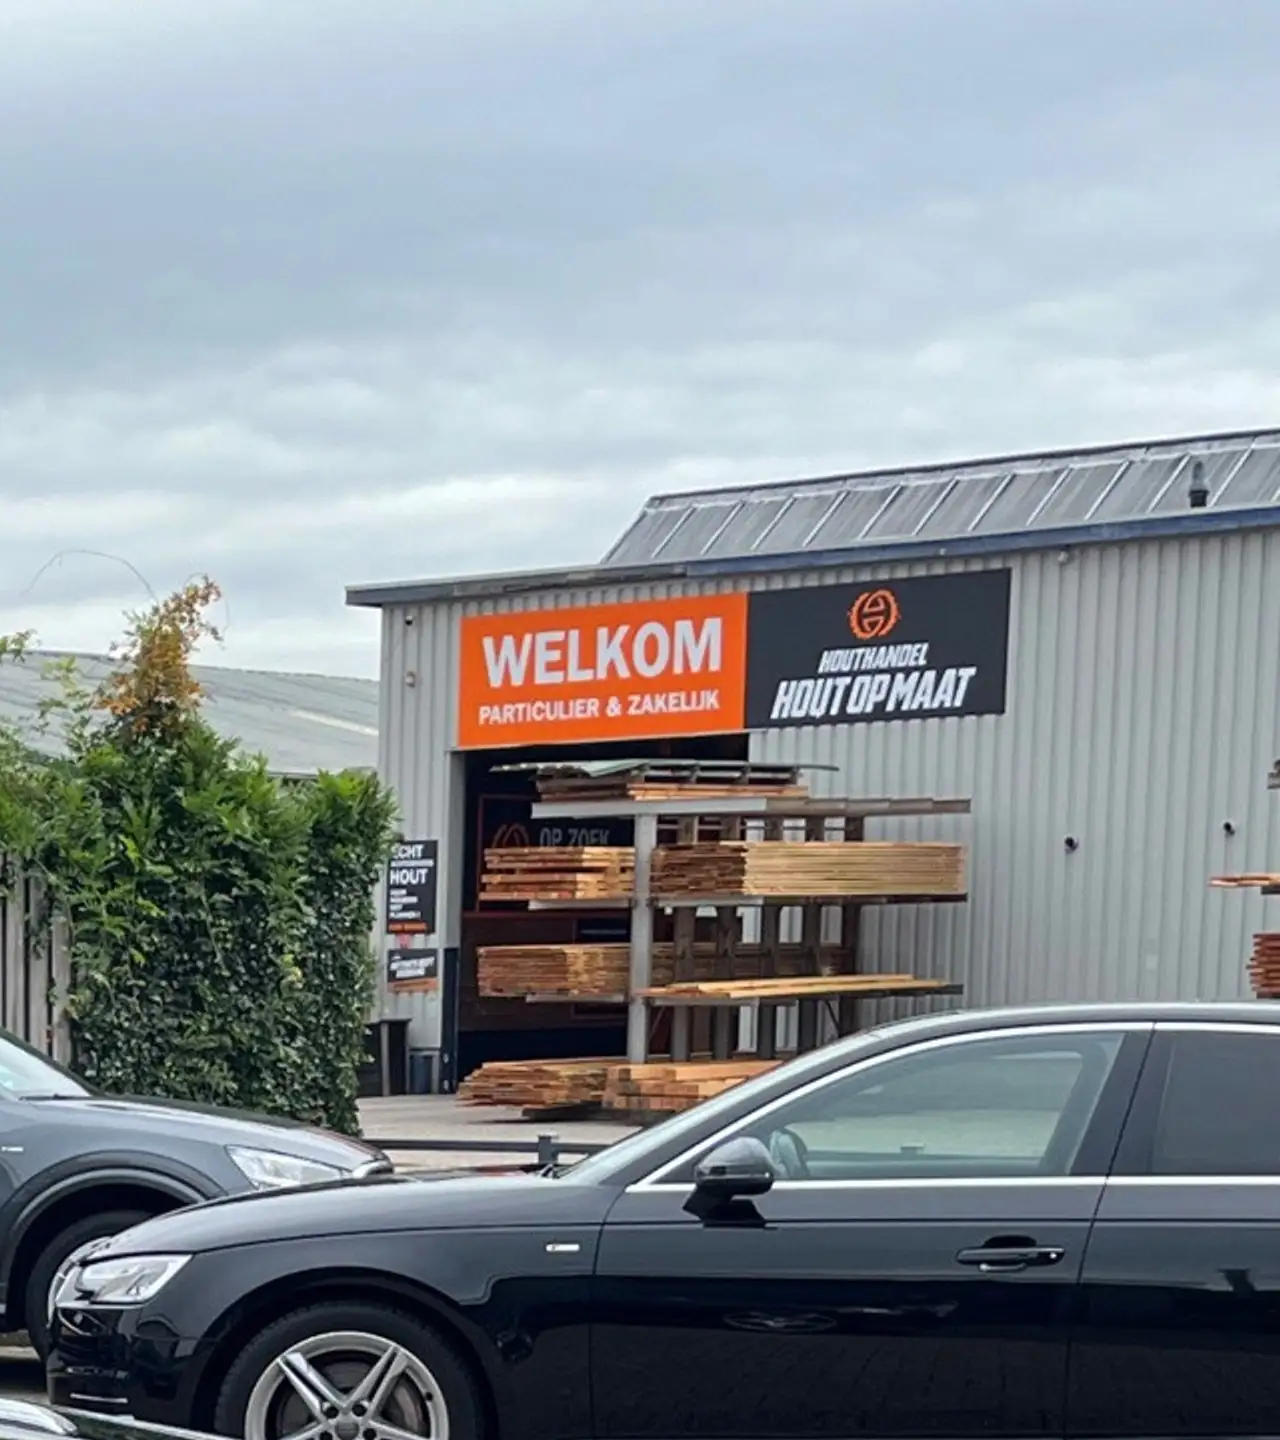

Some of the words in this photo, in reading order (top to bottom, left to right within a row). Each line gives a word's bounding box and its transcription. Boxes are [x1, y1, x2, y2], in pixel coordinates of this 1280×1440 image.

[482, 617, 722, 688] WELKOM
[817, 642, 929, 674] HOUTHANDEL
[478, 697, 599, 726] PARTICULIER
[607, 696, 621, 716] &
[628, 689, 720, 715] ZAKELIJK
[389, 868, 428, 886] HOUT
